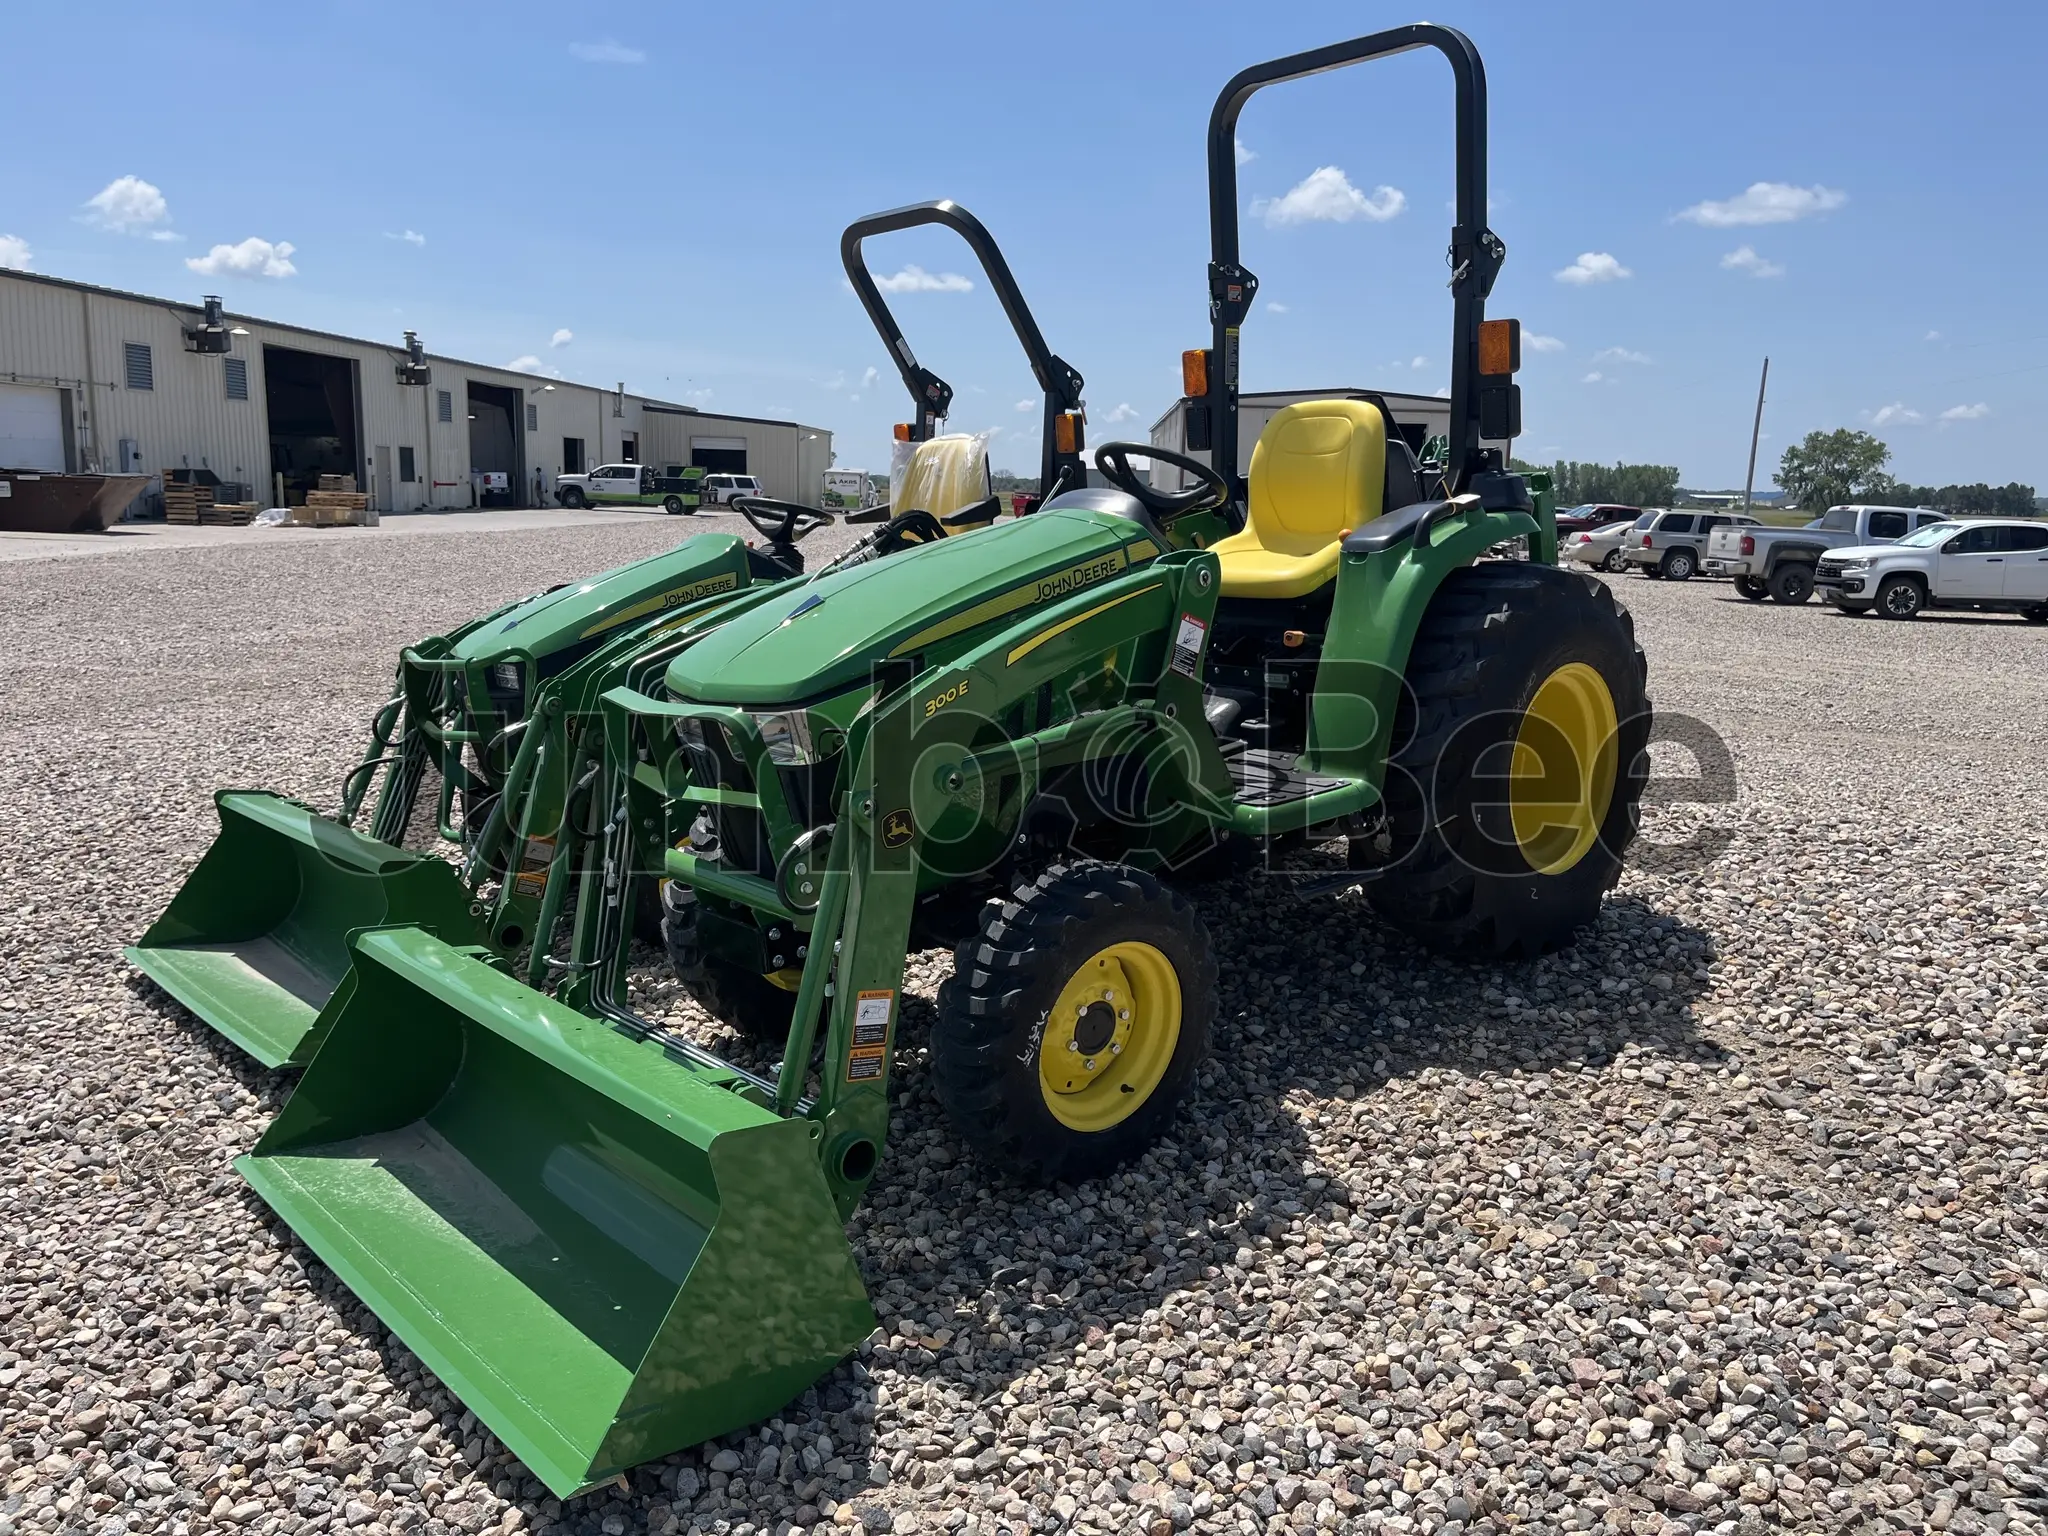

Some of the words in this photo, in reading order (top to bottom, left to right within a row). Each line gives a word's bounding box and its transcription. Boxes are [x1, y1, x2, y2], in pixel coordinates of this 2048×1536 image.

[663, 589, 694, 607] JOHN
[695, 579, 733, 596] DEERE
[1035, 575, 1072, 601] JOHN
[1073, 558, 1117, 586] DEERE
[859, 1049, 882, 1057] WARNING
